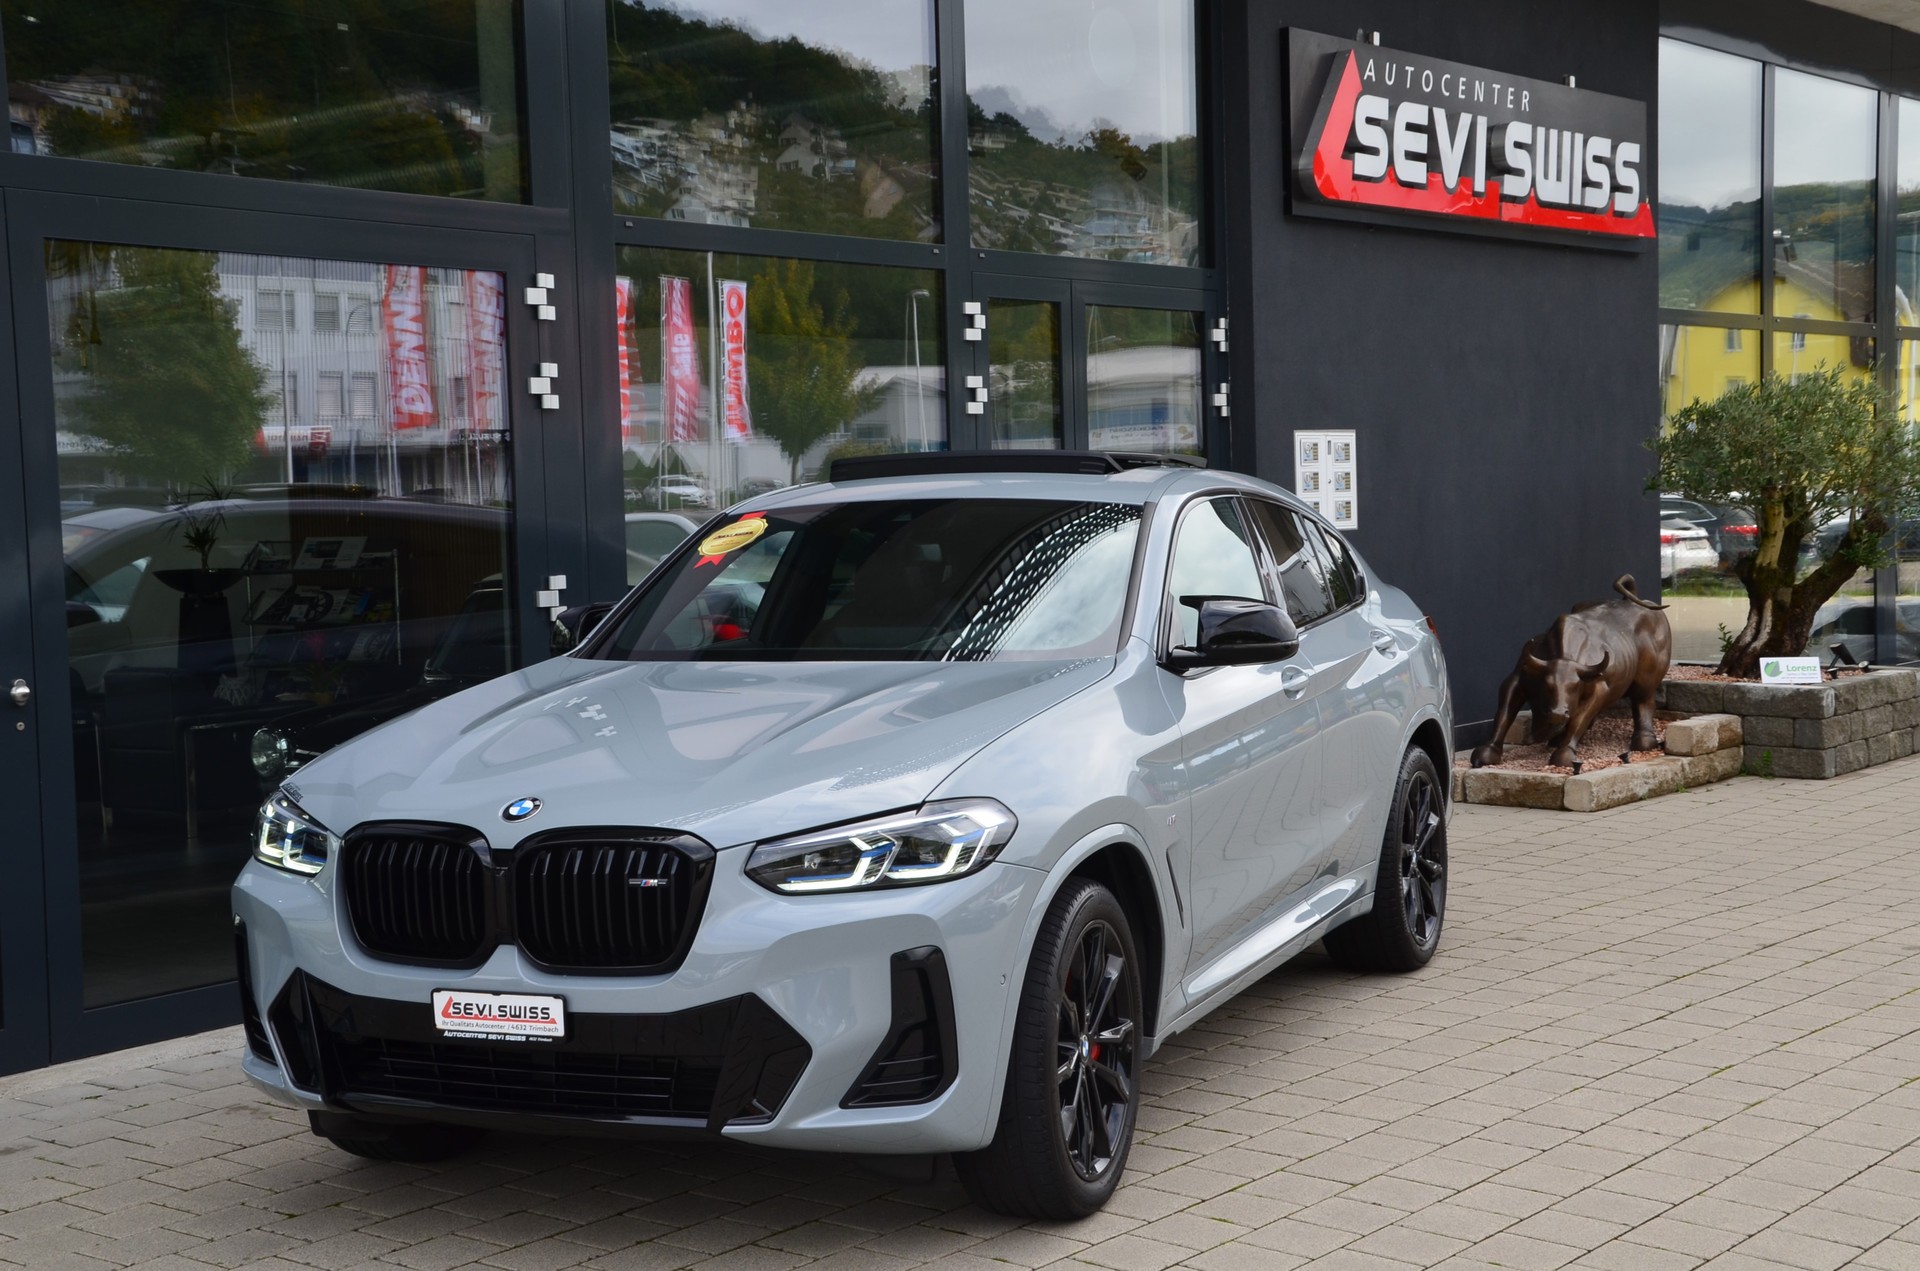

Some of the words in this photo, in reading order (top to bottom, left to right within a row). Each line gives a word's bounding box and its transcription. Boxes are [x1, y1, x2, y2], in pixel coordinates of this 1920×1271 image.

[1363, 57, 1531, 112] AUTOCENTER
[1353, 94, 1488, 193] SEVI
[1503, 120, 1641, 213] SWISS
[1786, 664, 1817, 672] Lorenz
[452, 1002, 492, 1017] SEVI
[498, 1004, 551, 1020] SWISS
[475, 1022, 506, 1031] Autocenter
[529, 1025, 559, 1033] Trimbach
